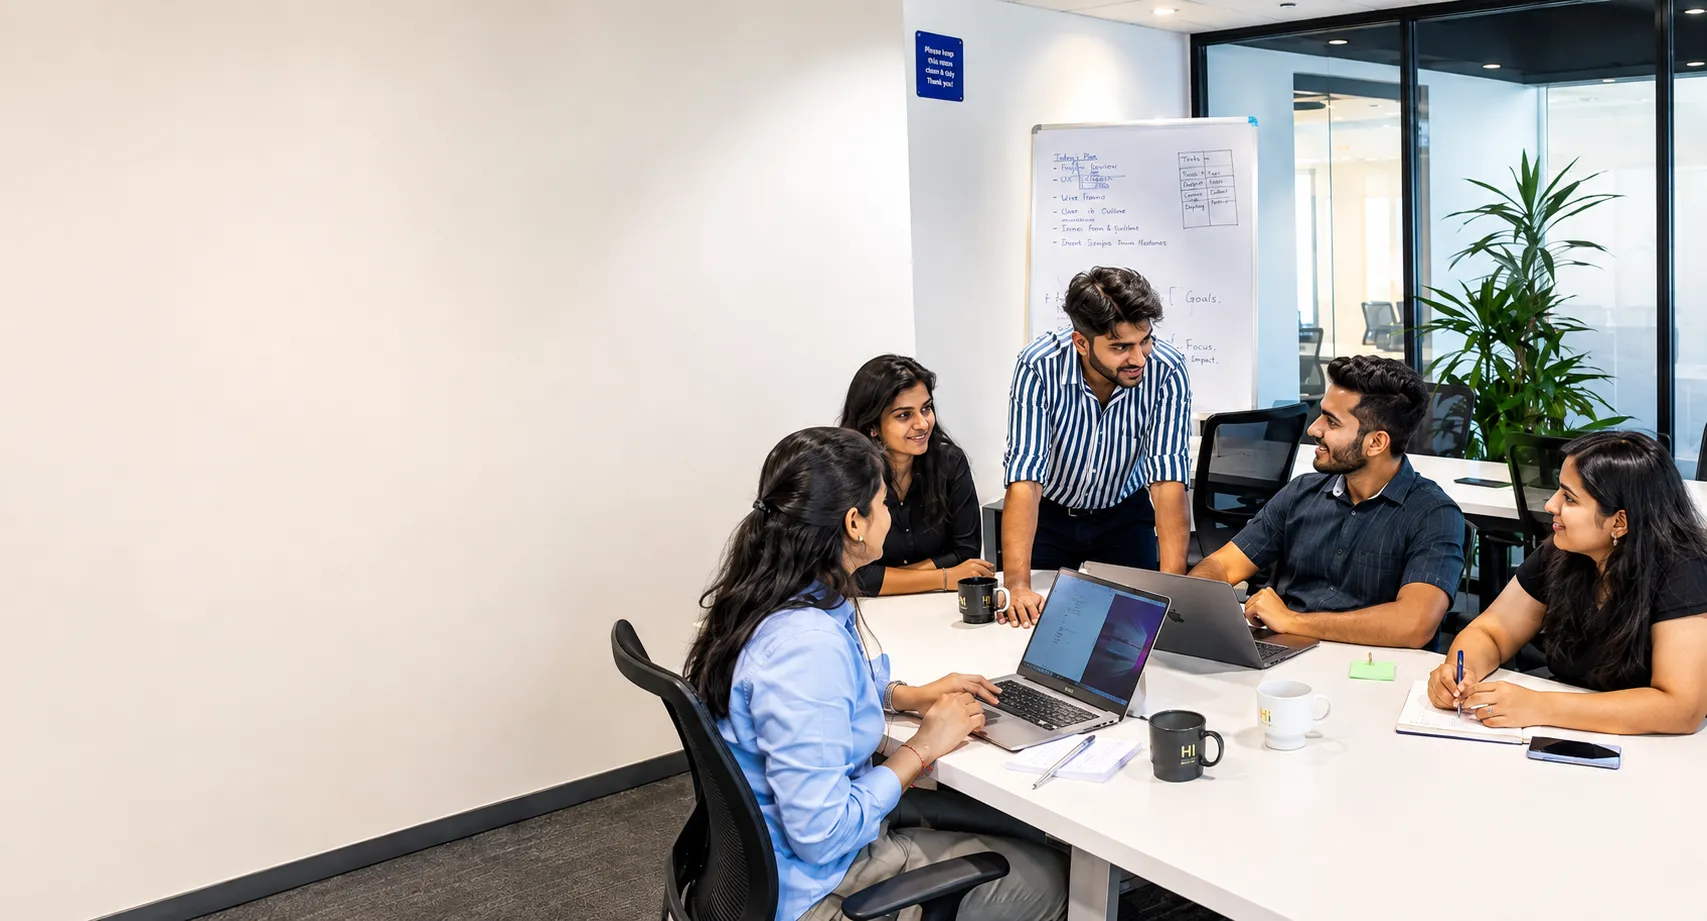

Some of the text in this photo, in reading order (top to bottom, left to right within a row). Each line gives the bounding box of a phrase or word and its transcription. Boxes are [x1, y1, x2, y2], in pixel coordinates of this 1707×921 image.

[925, 46, 941, 55] Please
[927, 77, 942, 85] Thank
[1181, 744, 1196, 758] HI
